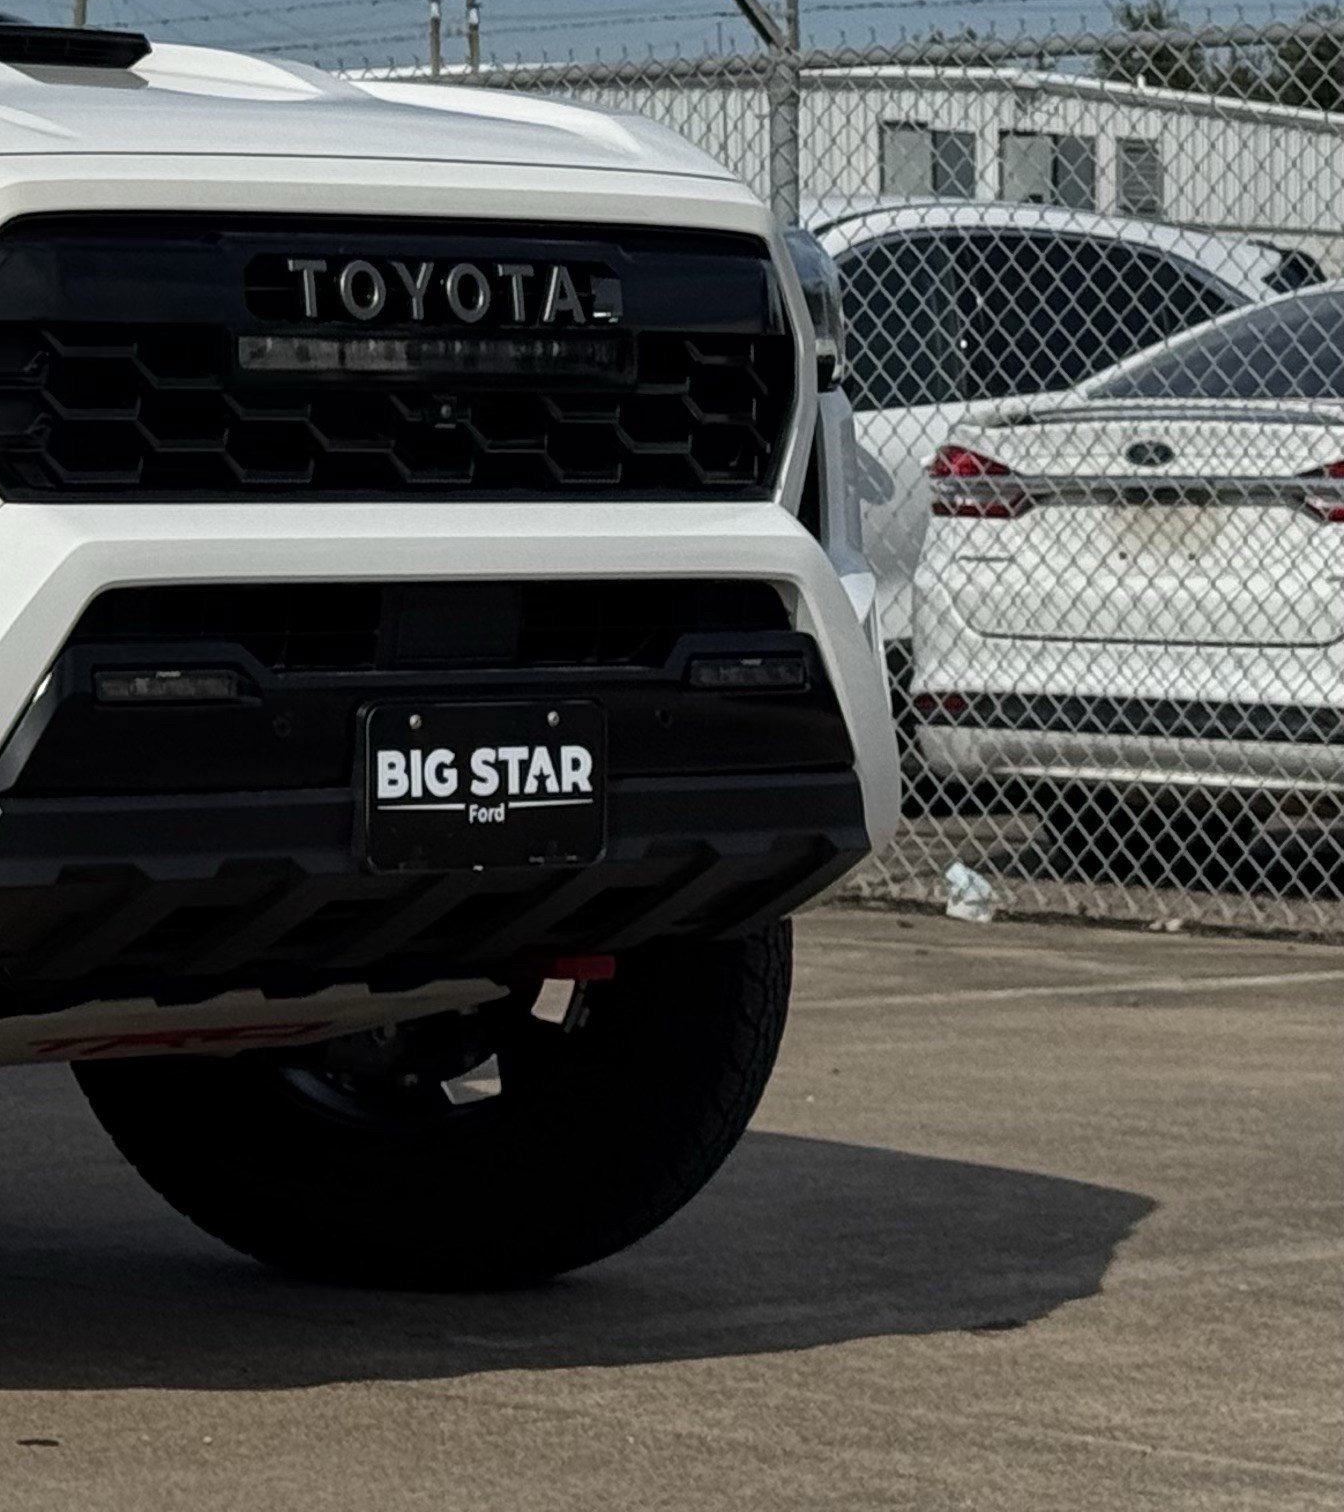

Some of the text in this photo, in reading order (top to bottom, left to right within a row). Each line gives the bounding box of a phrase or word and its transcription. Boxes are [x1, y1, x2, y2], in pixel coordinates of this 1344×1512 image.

[287, 259, 587, 324] TOYOTA
[376, 745, 594, 799] BIG STAR
[468, 803, 506, 824] Ford
